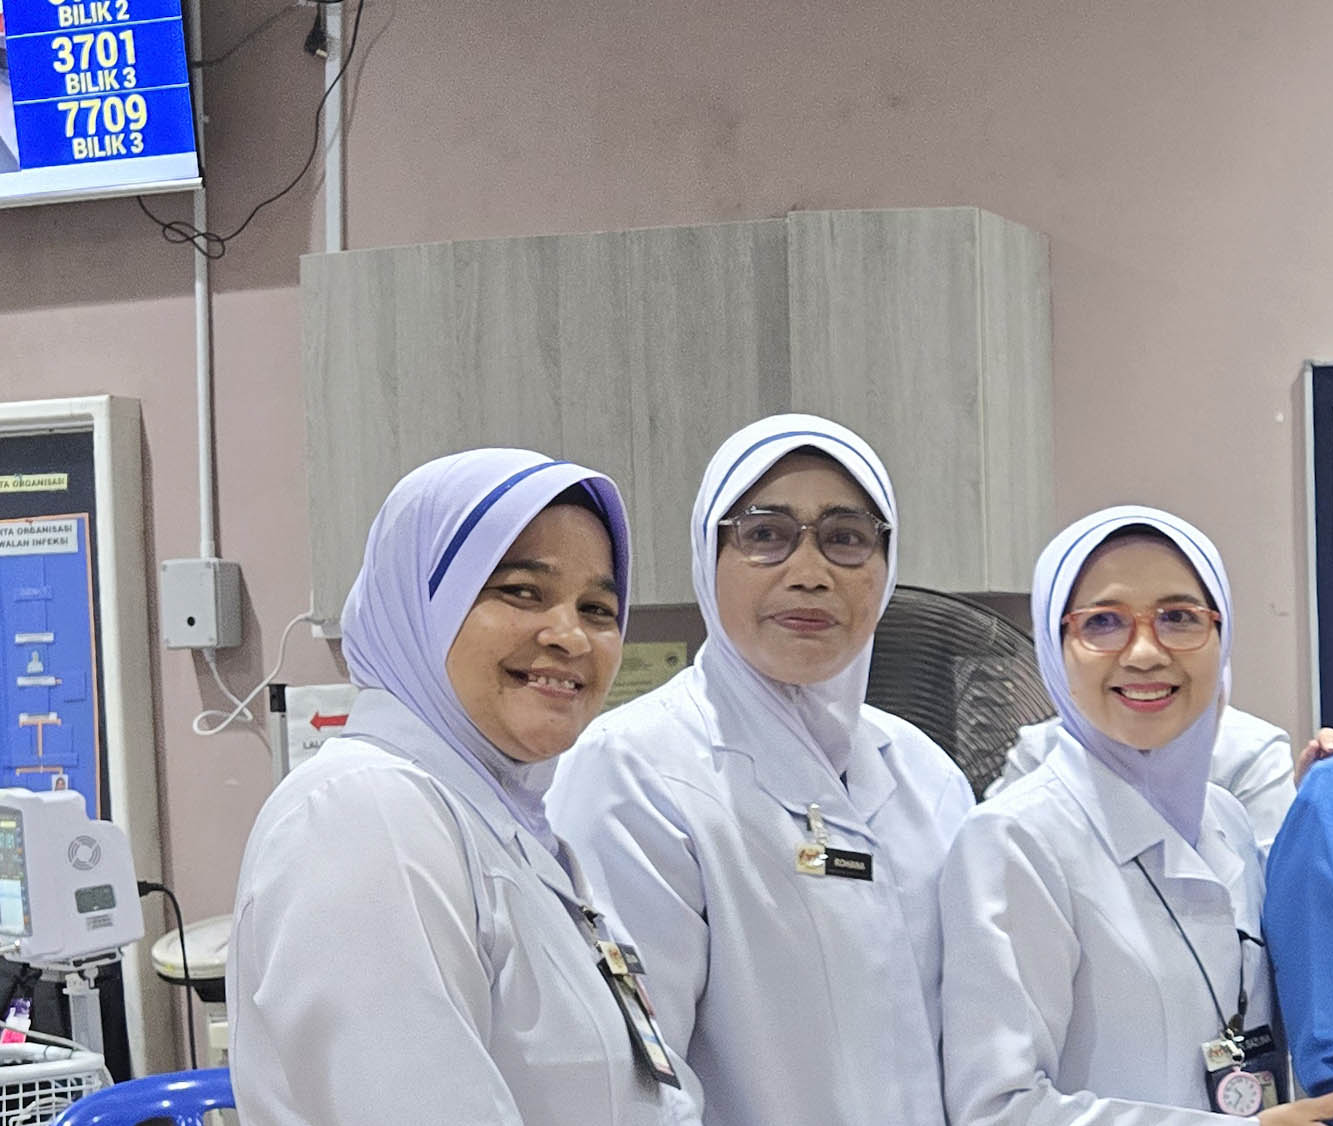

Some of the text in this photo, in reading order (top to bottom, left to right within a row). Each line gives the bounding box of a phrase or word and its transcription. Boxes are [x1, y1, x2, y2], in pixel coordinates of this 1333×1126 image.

[58, 0, 130, 27] BILIK 2
[51, 30, 136, 73] 3701
[65, 67, 137, 95] BILIK 3
[57, 94, 148, 137] 7709
[72, 132, 144, 159] BILIK 3
[12, 478, 65, 487] ORGANISASI
[16, 525, 72, 535] ORGANISASI
[32, 538, 69, 547] INFEKSI
